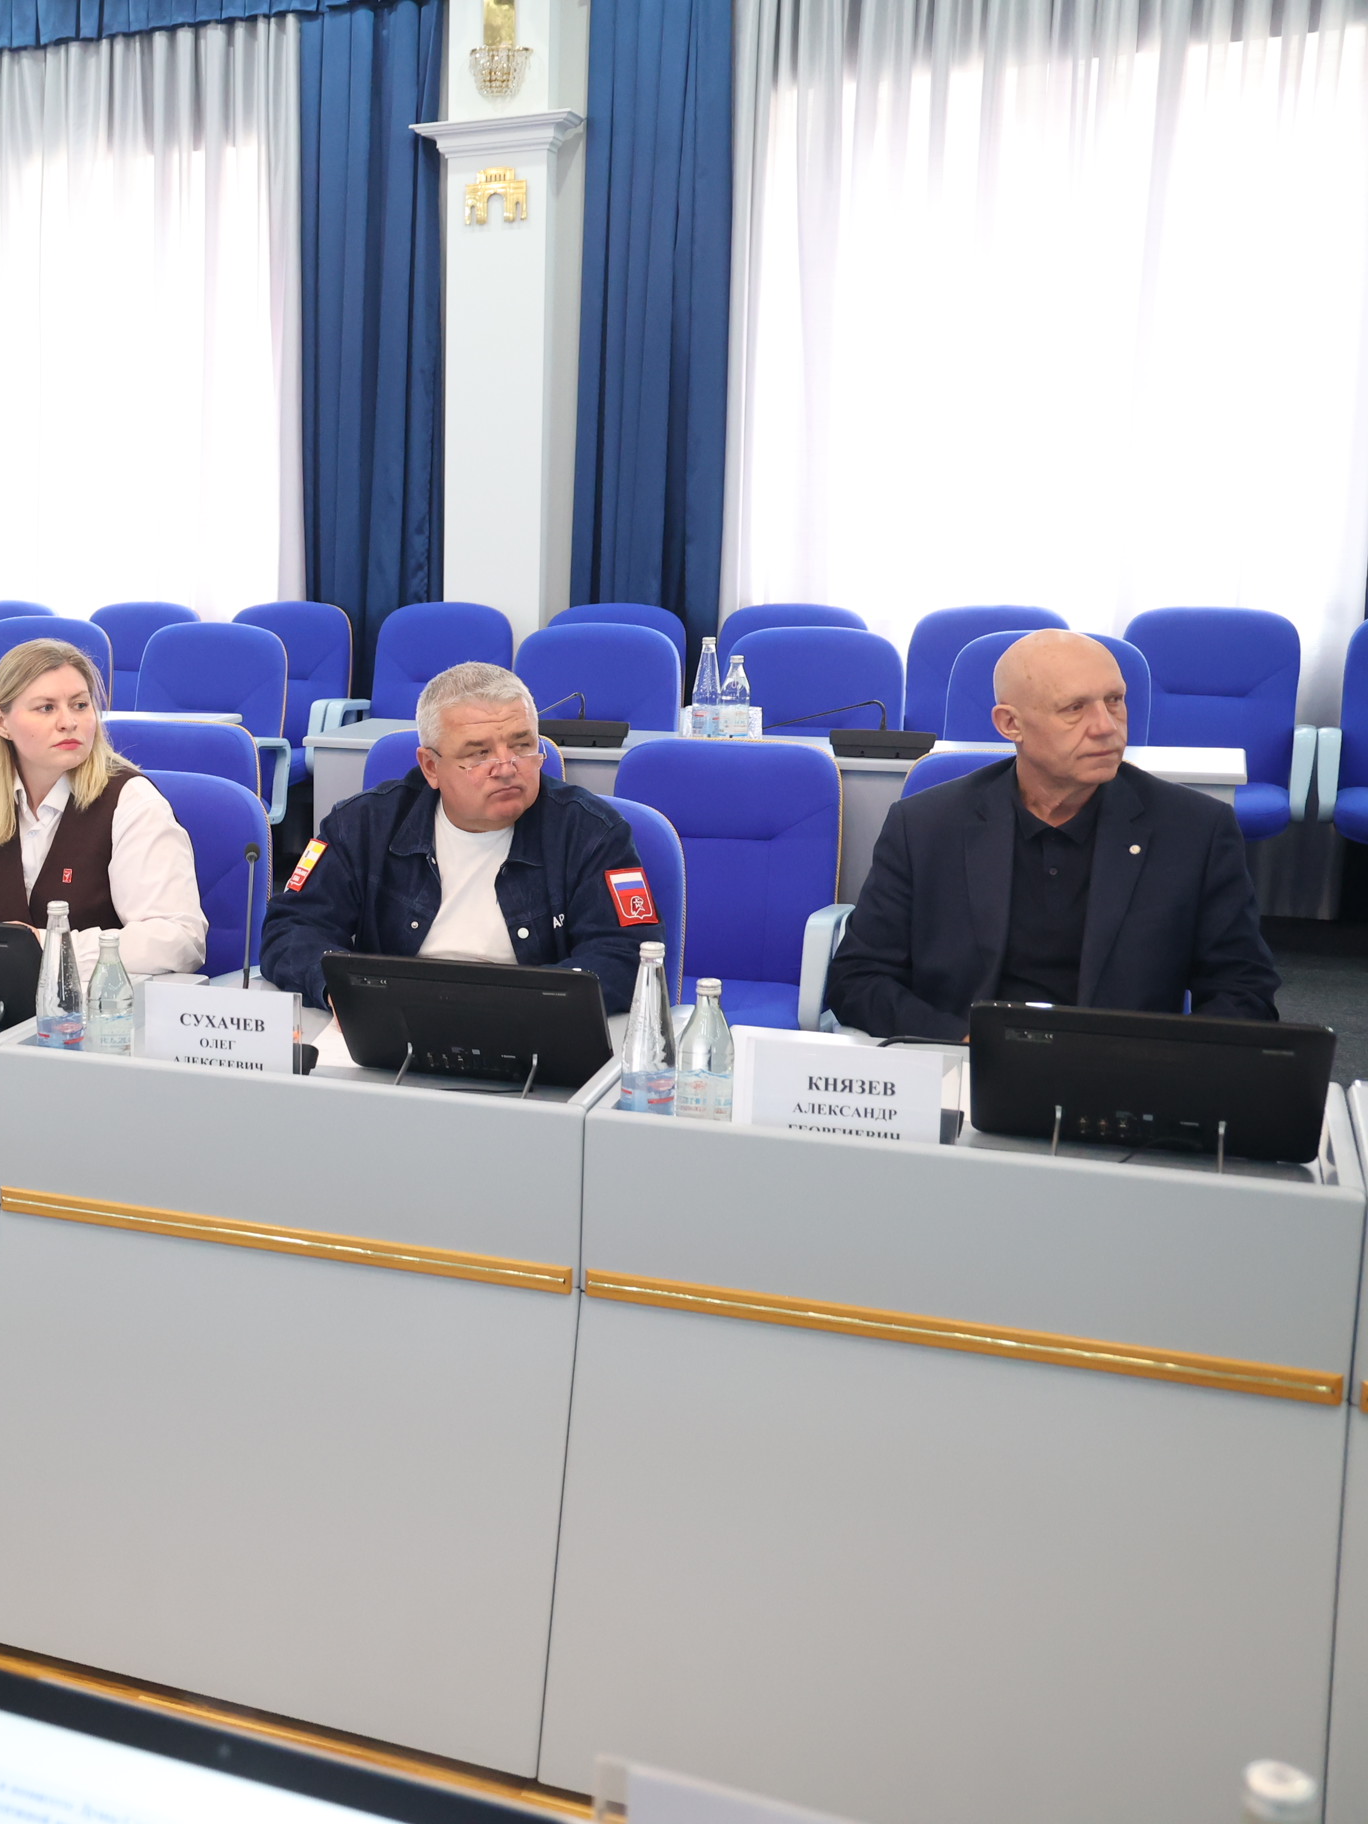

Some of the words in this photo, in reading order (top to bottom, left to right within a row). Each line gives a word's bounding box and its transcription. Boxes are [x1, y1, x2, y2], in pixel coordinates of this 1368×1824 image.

[179, 1012, 265, 1032] СУХАЧЕВ
[199, 1037, 237, 1050] ОЛЕГ
[807, 1075, 896, 1097] КНЯЗЕВ
[792, 1101, 898, 1121] АЛЕКСАНДР
